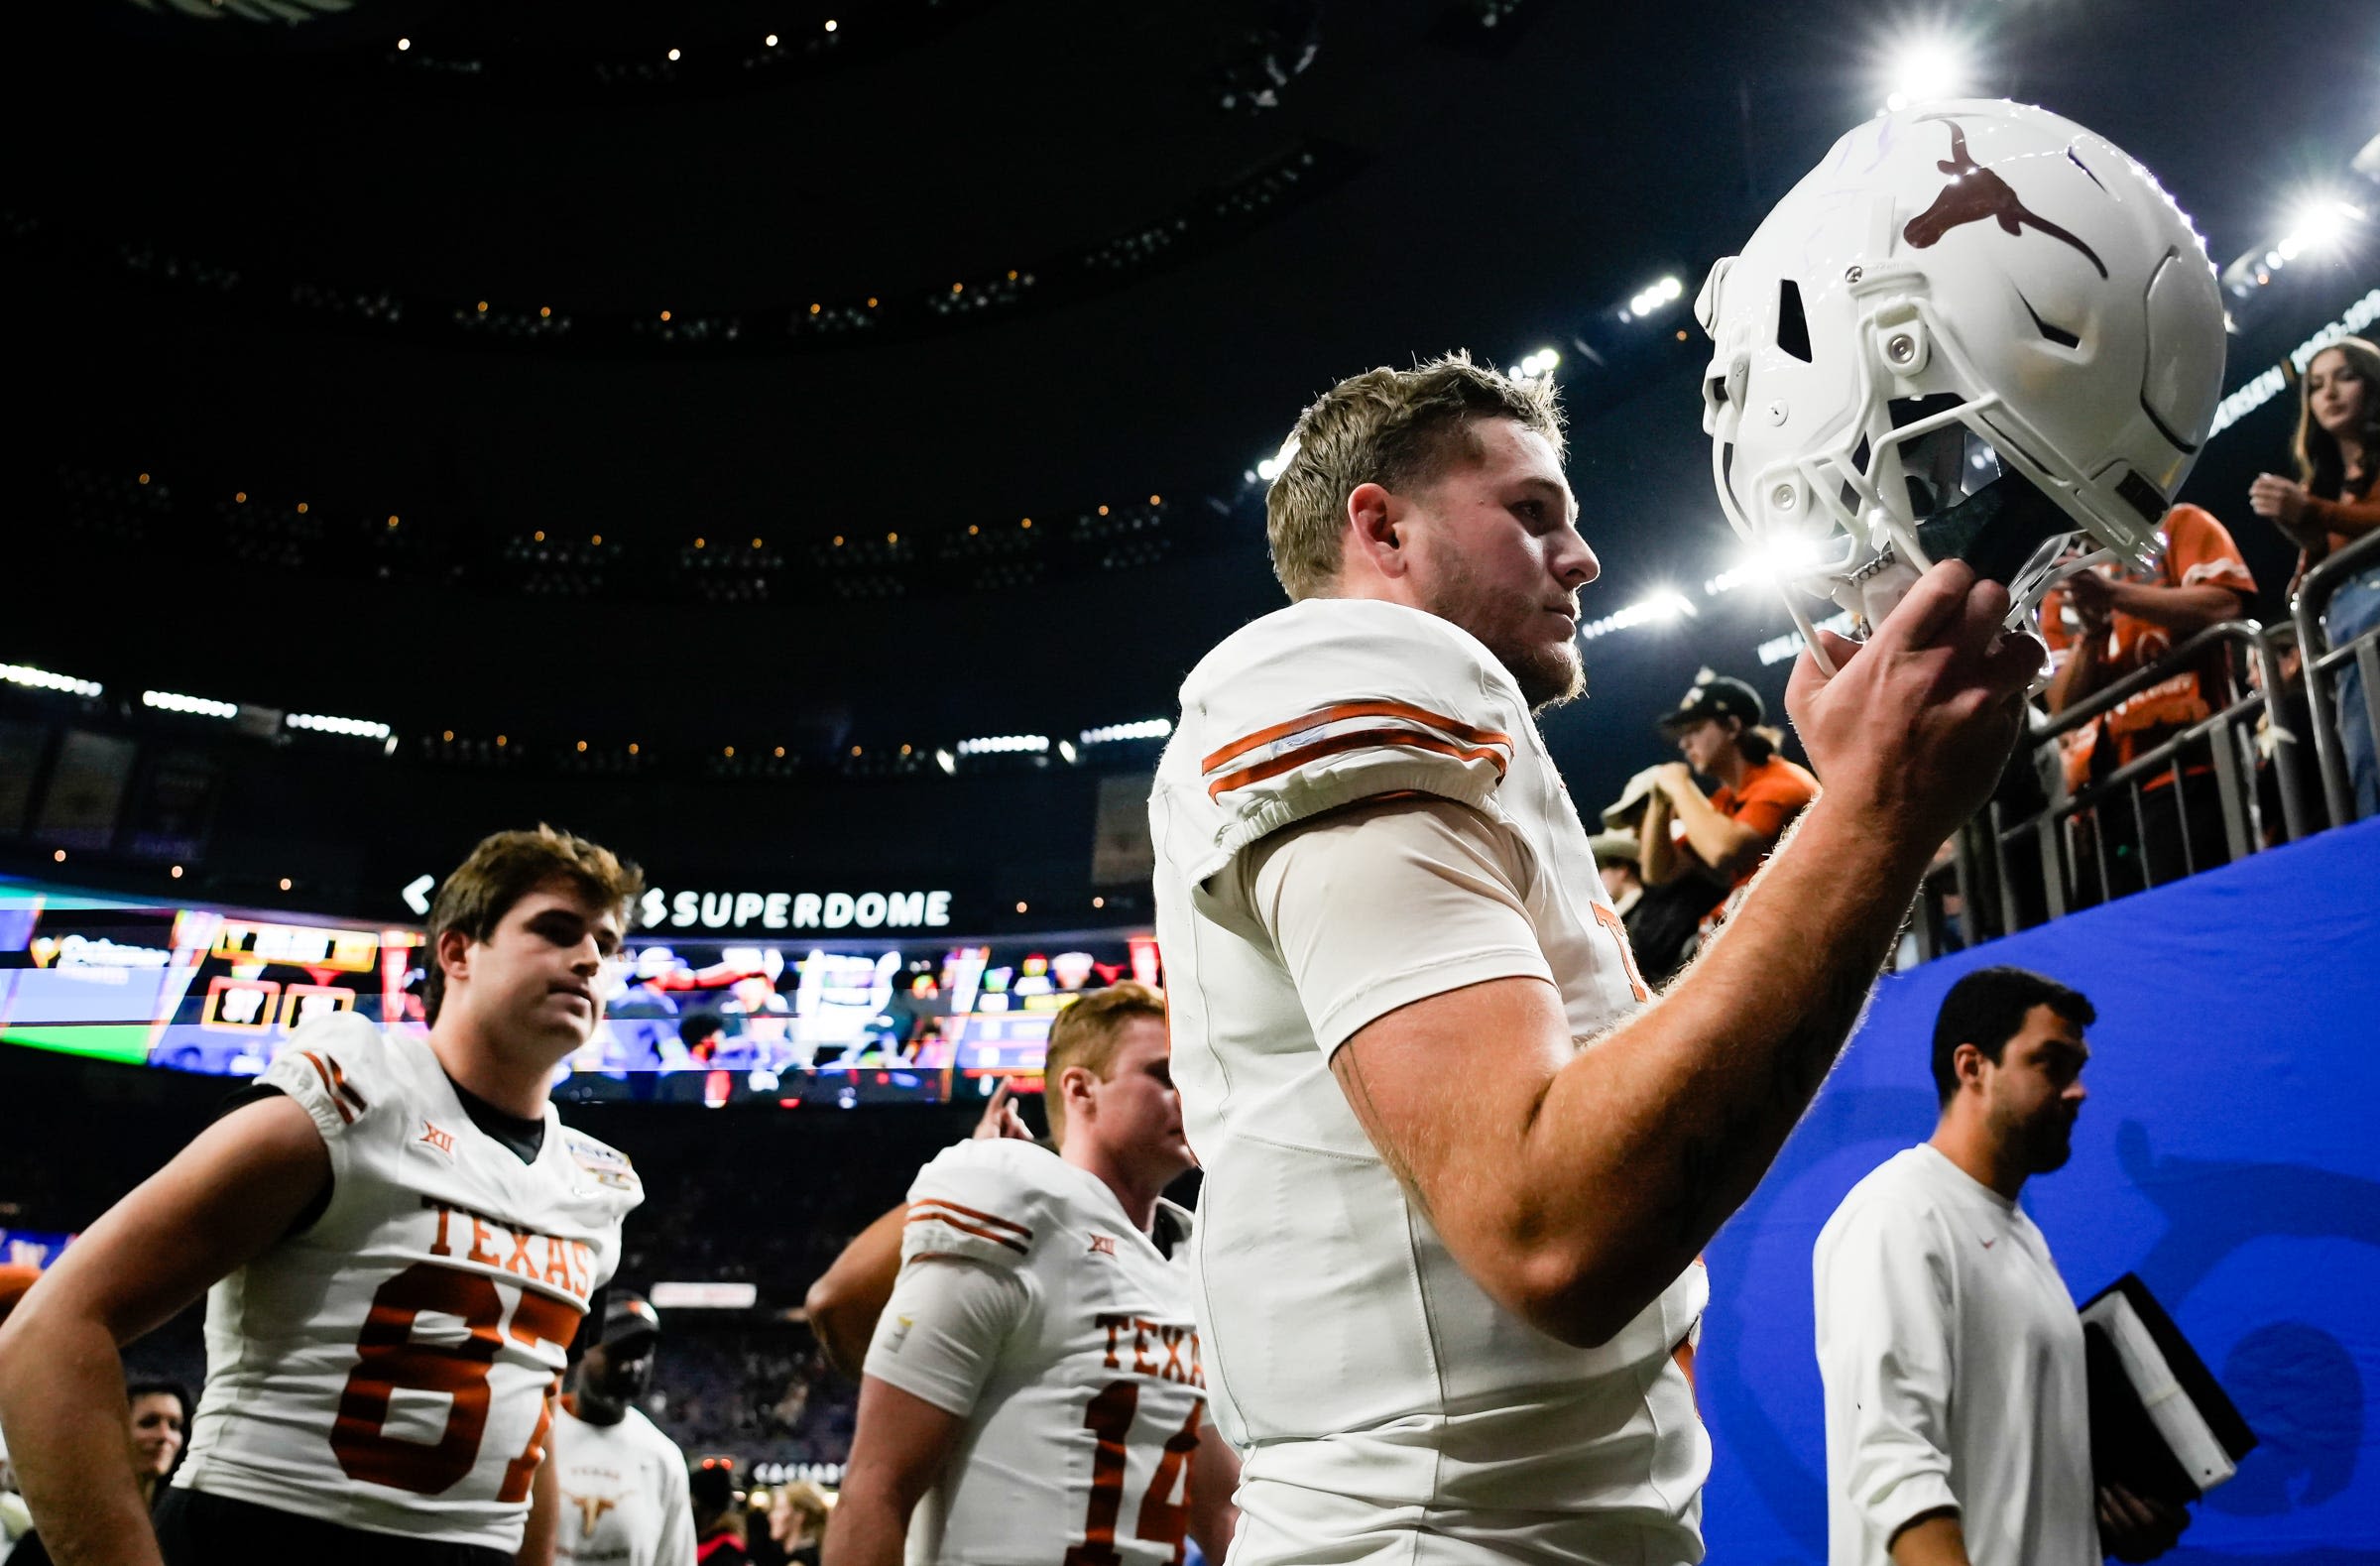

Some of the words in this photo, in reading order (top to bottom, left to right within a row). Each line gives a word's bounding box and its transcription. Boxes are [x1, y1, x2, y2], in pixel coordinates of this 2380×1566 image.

[2206, 364, 2286, 439] ERSEN
[670, 891, 952, 928] SUPERDOME
[420, 1120, 457, 1160] XII
[420, 1195, 589, 1310] TEXAS
[1088, 1233, 1118, 1262] XII
[329, 1262, 583, 1502] 87
[1095, 1314, 1206, 1389] TEXA
[754, 1462, 848, 1485] CAESAR
[1064, 1380, 1201, 1566] 14
